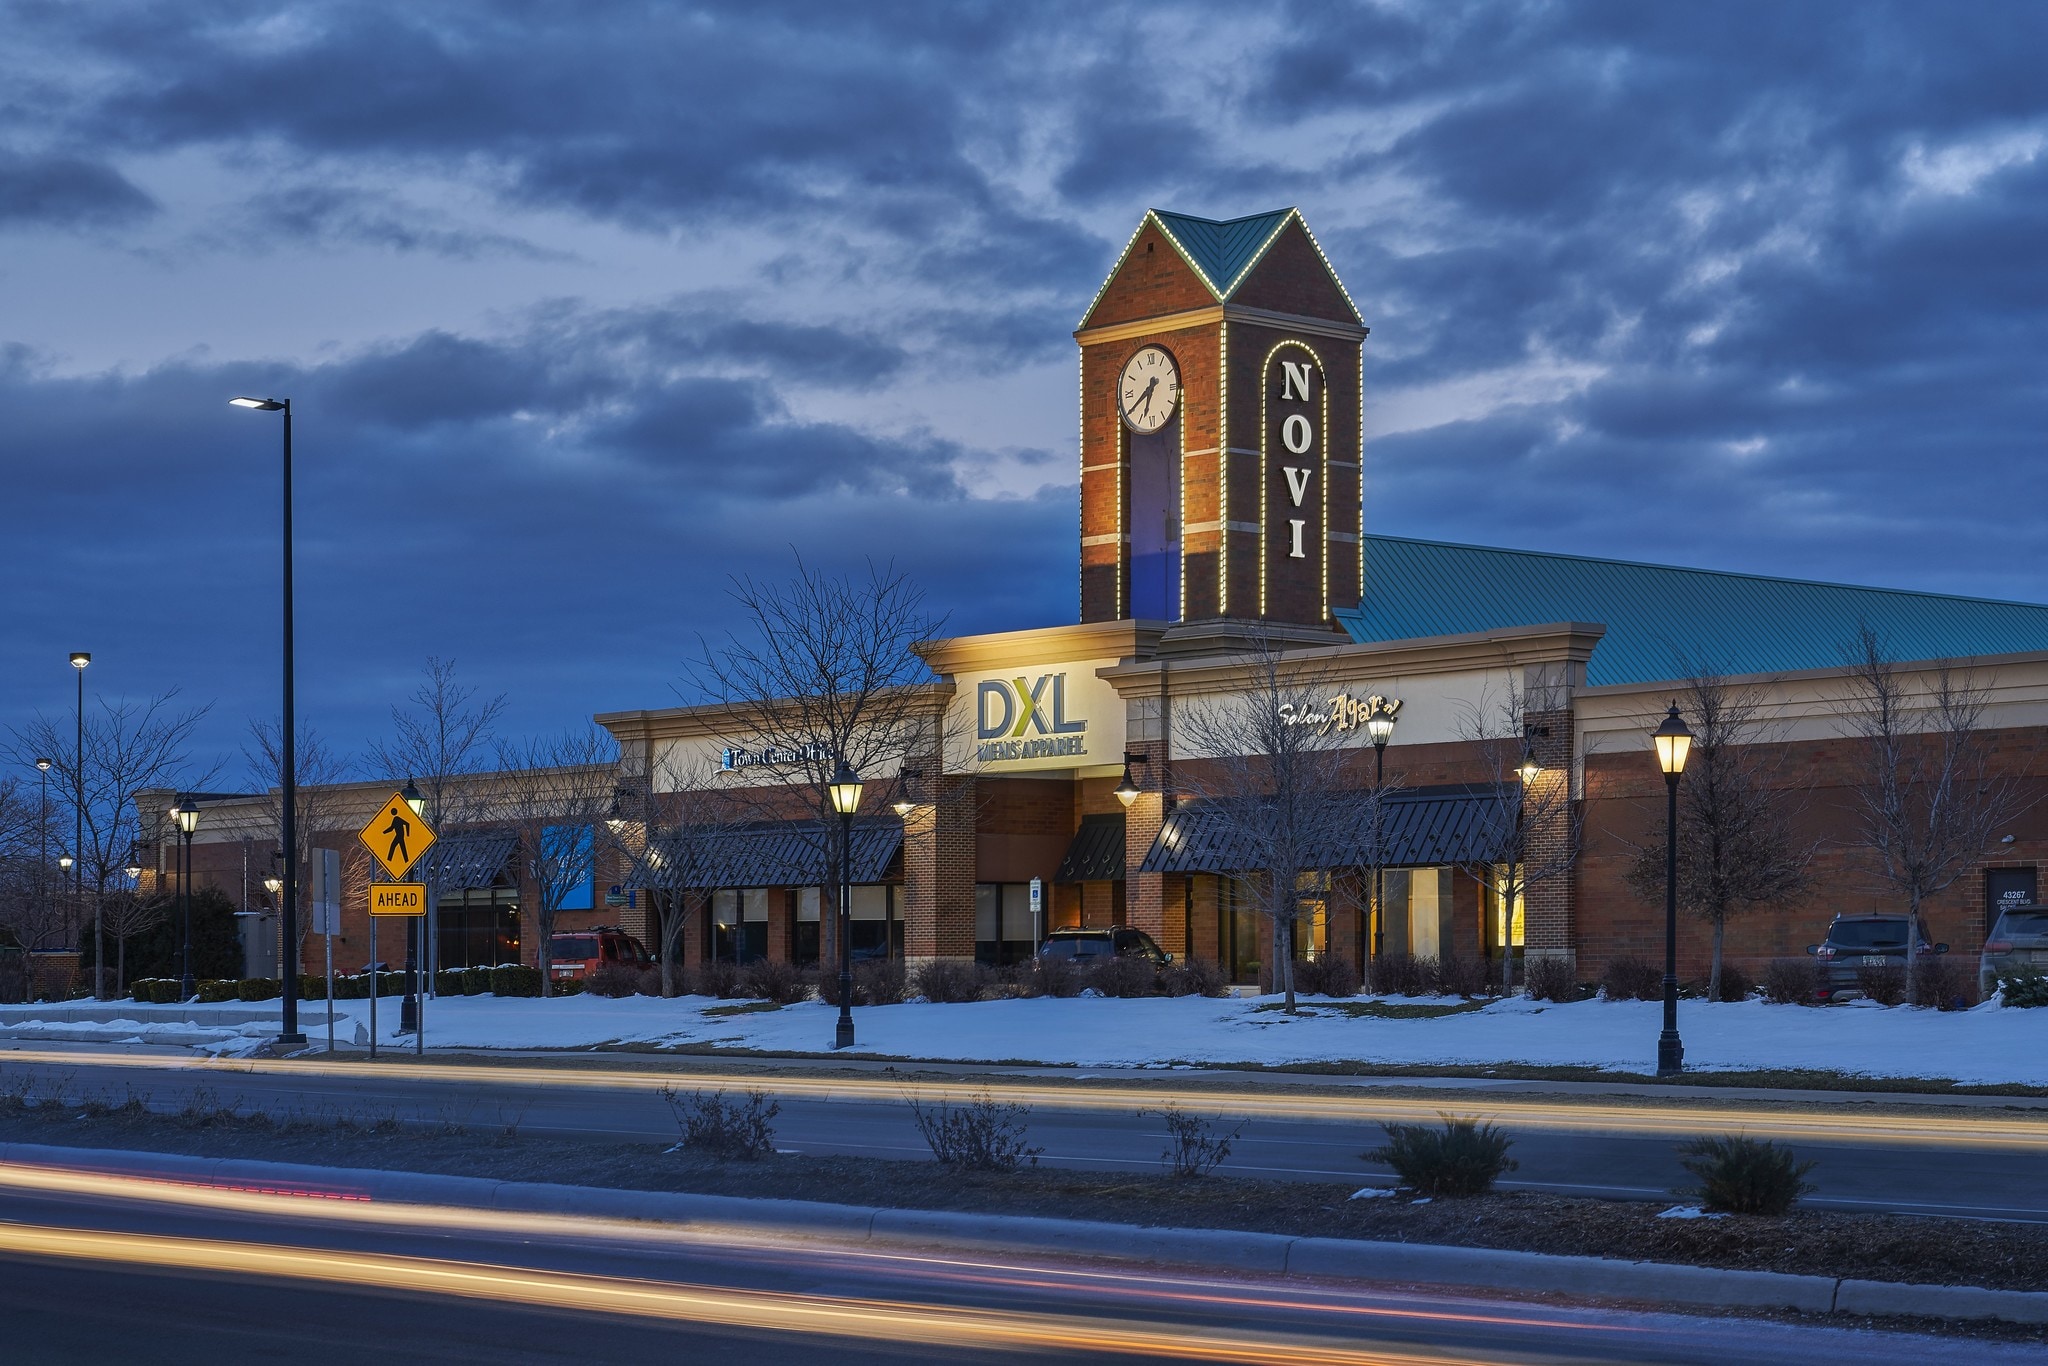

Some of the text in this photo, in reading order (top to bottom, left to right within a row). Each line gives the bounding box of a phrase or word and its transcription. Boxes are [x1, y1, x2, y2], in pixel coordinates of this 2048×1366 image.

[1281, 361, 1312, 558] NOVI
[978, 673, 1086, 739] DXL
[731, 749, 760, 767] Town
[762, 746, 796, 765] Center
[1021, 735, 1087, 760] APPAREL
[377, 892, 418, 907] AHEAD
[2003, 891, 2026, 899] 43267
